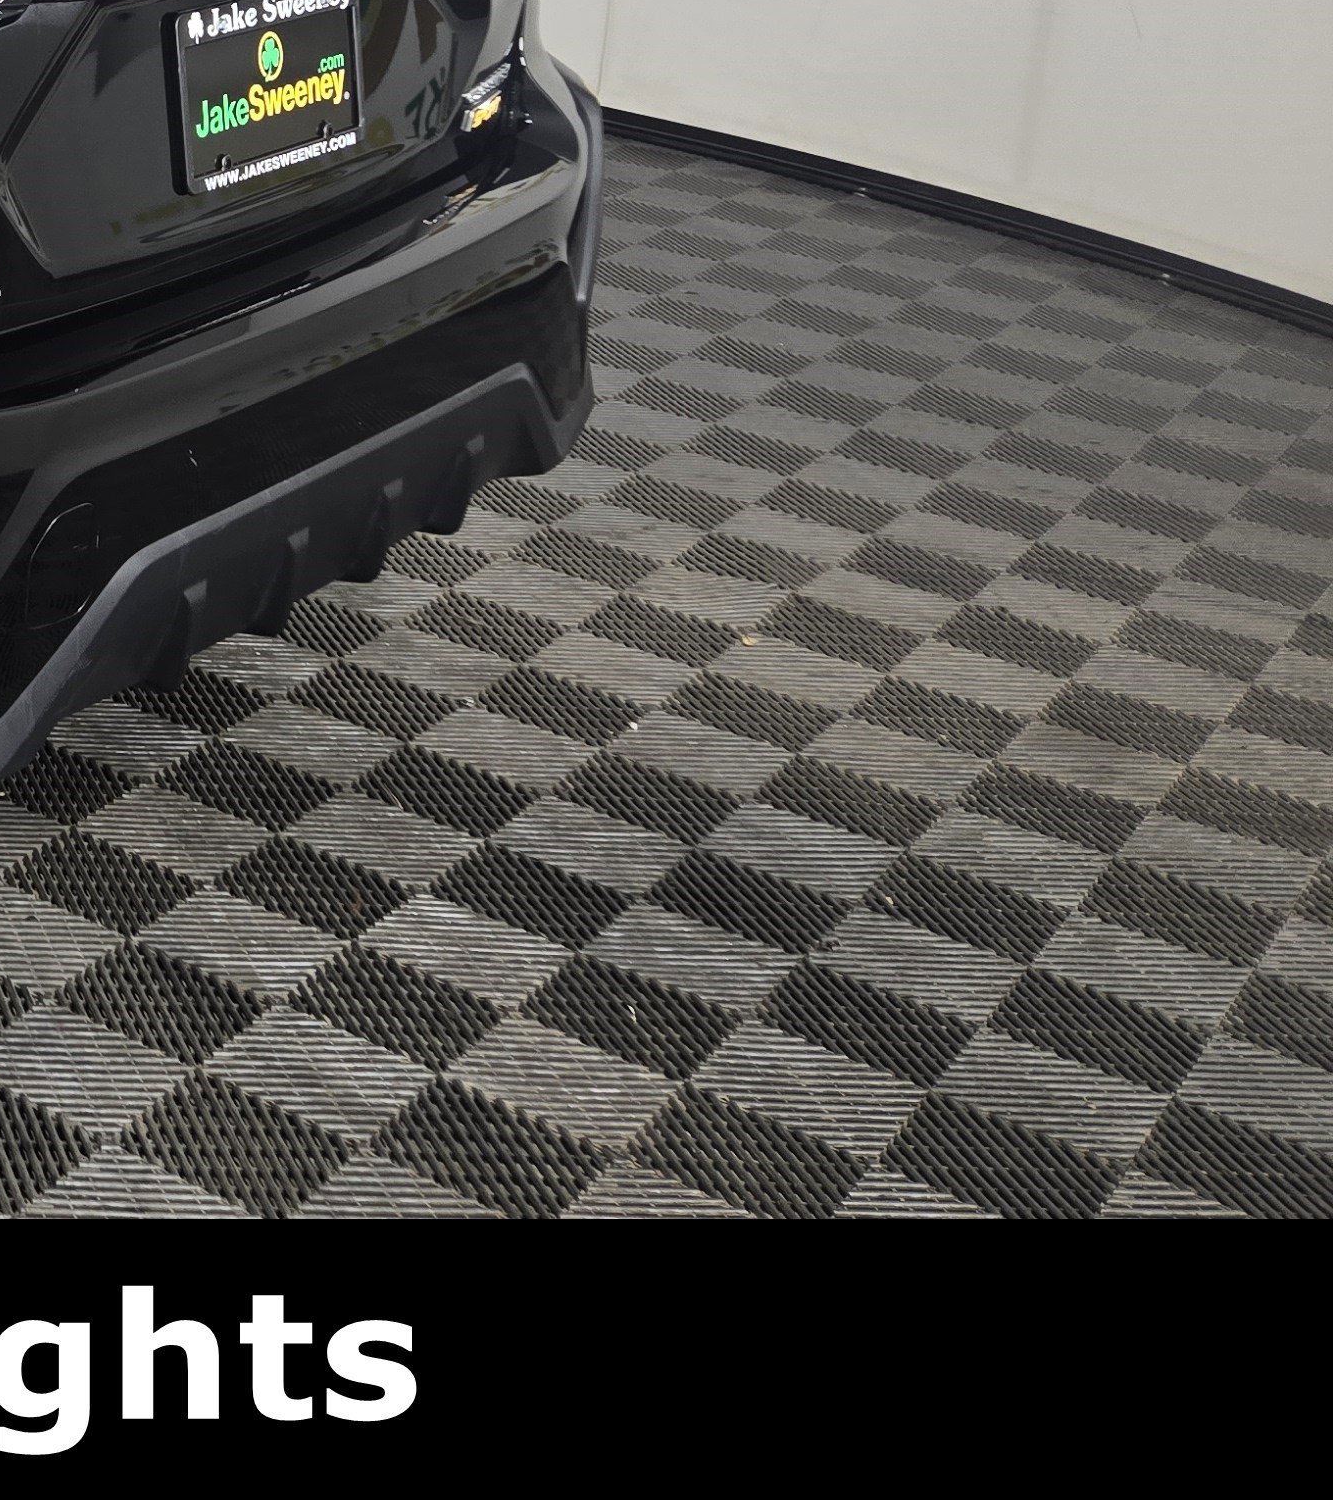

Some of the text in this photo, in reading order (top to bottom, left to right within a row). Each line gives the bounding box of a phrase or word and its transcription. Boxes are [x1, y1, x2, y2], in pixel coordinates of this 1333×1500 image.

[207, 4, 258, 37] Jake
[318, 53, 345, 73] .com
[204, 131, 356, 191] WWW.JAKESWEENEY.COM
